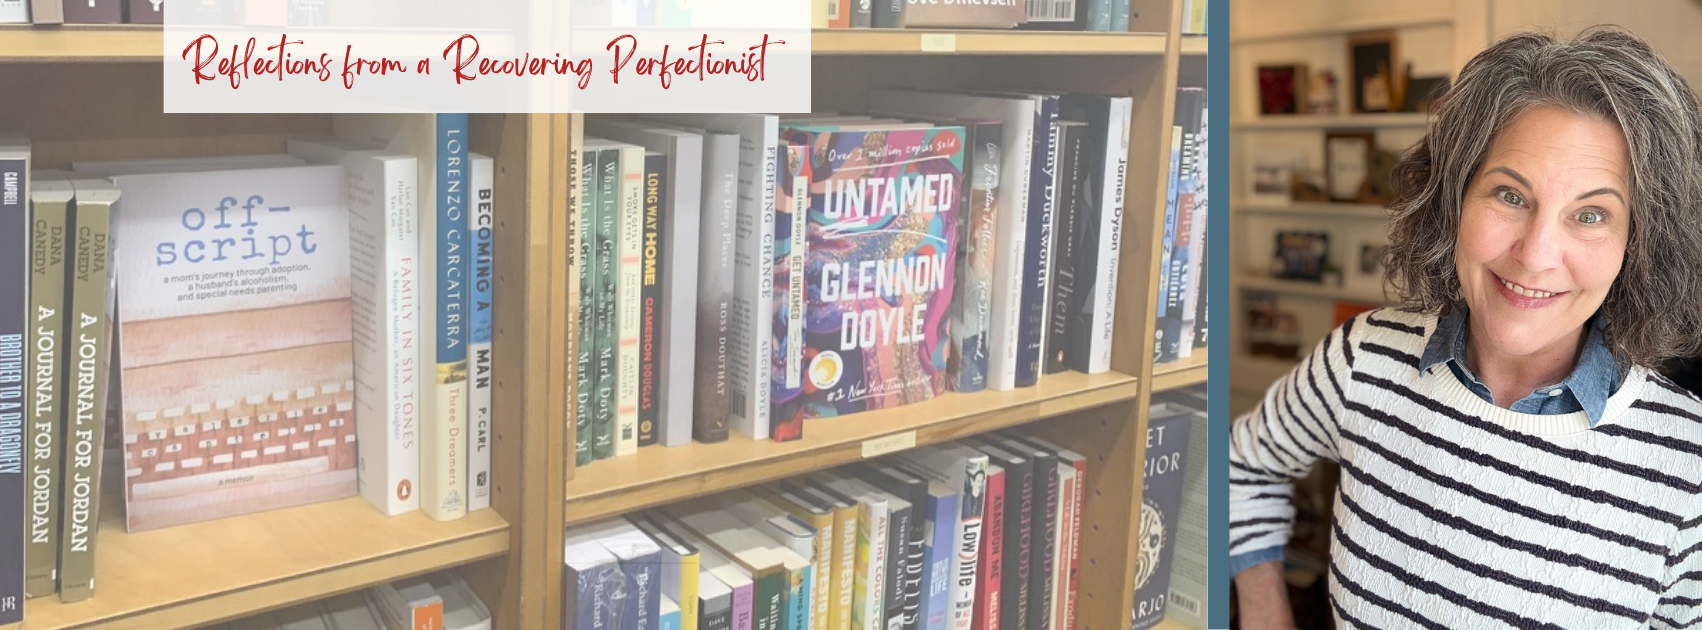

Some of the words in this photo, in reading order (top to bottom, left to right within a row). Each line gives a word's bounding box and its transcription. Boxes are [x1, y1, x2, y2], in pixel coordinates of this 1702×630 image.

[828, 149, 852, 162] Over
[867, 144, 902, 159] million
[905, 141, 934, 156] copies
[936, 137, 956, 151] sold
[1024, 128, 1032, 166] MARTIN
[1042, 112, 1058, 178] Tammy
[1072, 138, 1080, 181] FRANCINE
[1180, 132, 1194, 181] DREAMING
[4, 171, 18, 206] CAMPBELL
[447, 129, 461, 221] LORENZO
[582, 162, 593, 197] What
[603, 161, 615, 196] What
[646, 173, 659, 204] LONG
[724, 171, 734, 194] The
[764, 146, 776, 223] FIGHTING
[1071, 184, 1077, 196] DU
[1115, 157, 1126, 204] James
[181, 195, 291, 232] off-
[582, 201, 591, 214] Is
[603, 200, 615, 212] Is
[720, 199, 733, 229] Deep
[823, 173, 954, 219] UNTAMED
[582, 218, 591, 239] the
[602, 216, 614, 236] the
[646, 204, 658, 230] WAY
[794, 223, 802, 246] DOYLE
[1037, 185, 1054, 288] Duckworth
[1110, 206, 1123, 251] Dyson
[35, 219, 47, 276] CANEDY
[50, 226, 62, 267] DANA
[78, 226, 91, 283] CANEDY
[93, 233, 106, 274] DANA
[156, 224, 317, 267] script
[476, 188, 492, 293] BECOMING
[602, 239, 613, 276] Grass
[643, 232, 657, 286] HOME
[721, 233, 731, 268] Places
[171, 273, 200, 283] mom's
[202, 270, 235, 282] journey
[236, 266, 270, 277] through
[580, 242, 591, 279] Grass
[761, 233, 773, 298] CHANCE
[792, 255, 803, 273] GET
[820, 252, 947, 303] GLENNON
[177, 293, 195, 302] and
[196, 288, 227, 300] special
[228, 286, 255, 297] needs
[256, 282, 298, 295] parenting
[195, 279, 240, 290] husband's
[401, 256, 412, 321] FAMILY
[446, 229, 461, 349] CARCATERRA
[790, 275, 802, 320] UNTAMED
[1054, 266, 1074, 335] Them
[38, 305, 56, 322] A
[81, 312, 98, 329] A
[477, 301, 490, 312] A
[719, 302, 728, 332] ROSS
[1105, 311, 1112, 320] A
[402, 331, 413, 349] IN
[643, 297, 654, 362] CAMERON
[840, 303, 928, 351] DOYLE
[1103, 321, 1112, 340] Life
[0, 333, 22, 382] BROTHER
[35, 329, 55, 418] JOURNAL
[403, 357, 413, 385] SIX
[476, 349, 490, 389] MAN
[577, 352, 590, 387] Mark
[599, 347, 612, 382] Mark
[717, 337, 727, 396] DOUTHAT
[760, 339, 768, 379] ALICIA
[0, 384, 22, 399] TO
[77, 334, 97, 425] JOURNAL
[642, 362, 654, 410] DOUGLAS
[826, 388, 846, 402] #1
[848, 379, 868, 399] New
[868, 380, 885, 394] York
[0, 402, 22, 410] A
[448, 387, 460, 423] Three
[577, 393, 589, 426] Doty
[597, 386, 612, 421] Doty
[759, 382, 767, 419] DOYLE
[402, 392, 414, 450] TONES
[477, 420, 488, 452] CARL
[1145, 425, 1166, 449] ET
[0, 411, 21, 474] DRAGONFLY
[34, 422, 52, 461] FOR
[75, 430, 93, 469] FOR
[448, 427, 460, 487] Dreamers
[224, 474, 255, 485] memoir
[1074, 470, 1083, 515] DEBORAH
[32, 465, 50, 544] JORDAN
[71, 473, 90, 552] JORDAN
[1043, 467, 1058, 573] GIRLHOOD
[878, 516, 886, 536] ALL
[898, 515, 908, 555] Susan
[991, 495, 1003, 556] ABANDON
[1018, 472, 1033, 578] GIRLHOOD
[1072, 517, 1081, 560] FELDMAN
[817, 525, 833, 614] MANIFESTO
[839, 518, 856, 606] MANIFESTO
[876, 540, 885, 562] THE
[990, 559, 1000, 581] ME
[637, 573, 649, 619] Richard
[872, 565, 882, 614] COLORS
[895, 559, 907, 601] Faludi
[902, 538, 926, 625] FIDELIS
[930, 577, 948, 597] LIFE
[593, 584, 604, 628] Richard
